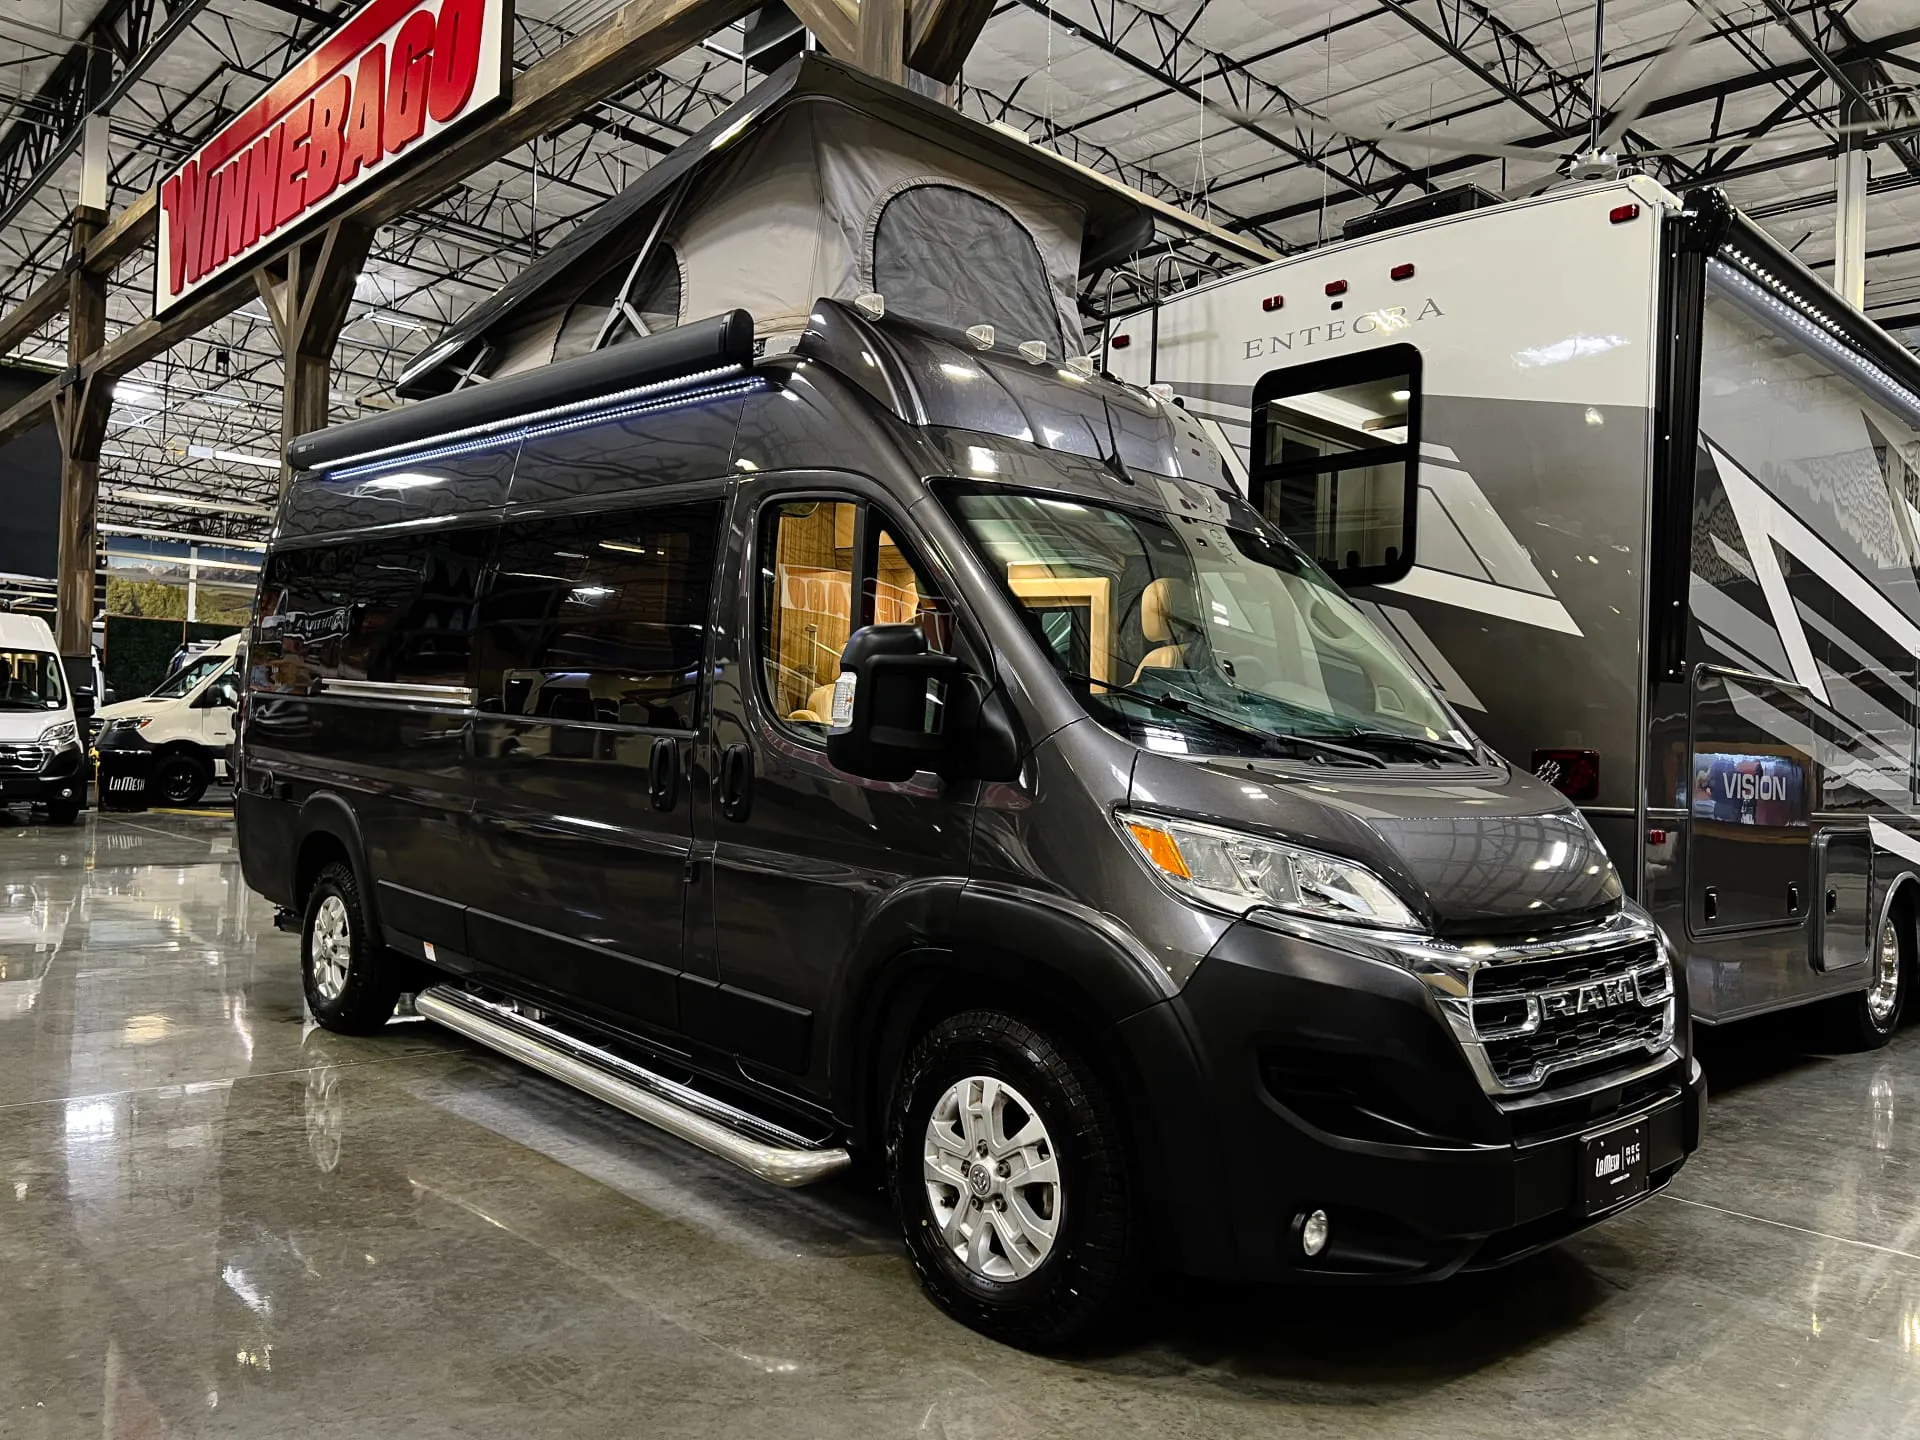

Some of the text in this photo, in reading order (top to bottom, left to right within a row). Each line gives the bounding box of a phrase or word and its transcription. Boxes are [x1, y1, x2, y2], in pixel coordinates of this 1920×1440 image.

[162, 0, 485, 296] WINNEBAGO
[1722, 772, 1787, 801] VISION
[1540, 979, 1634, 1020] RAM
